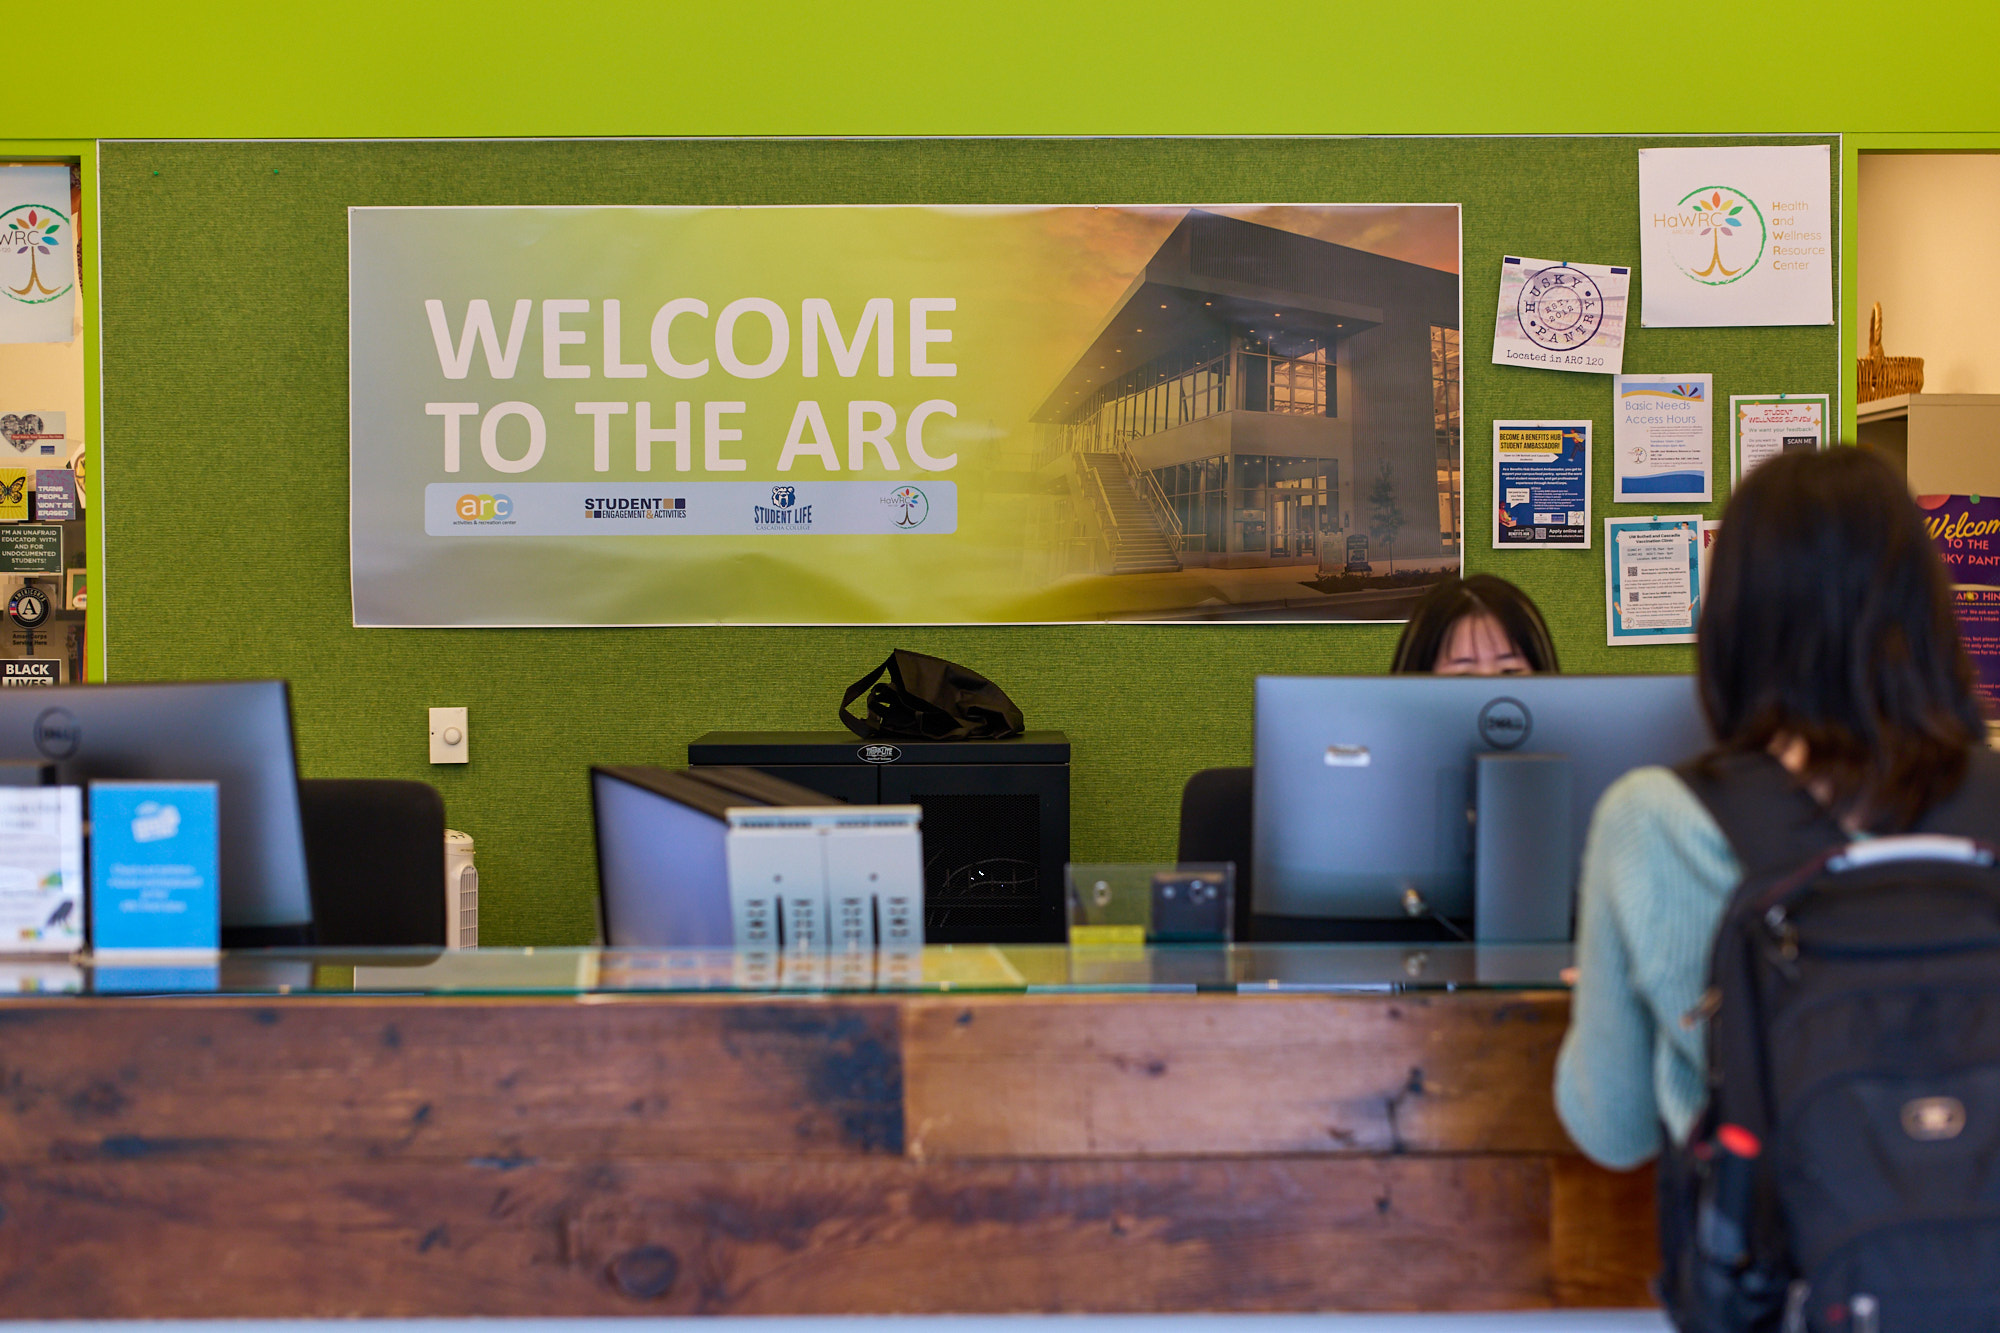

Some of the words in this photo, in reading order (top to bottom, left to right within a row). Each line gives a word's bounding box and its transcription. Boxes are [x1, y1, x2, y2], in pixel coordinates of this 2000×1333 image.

[1771, 200, 1809, 211] Health
[1653, 211, 1723, 228] HaWRC
[1771, 216, 1794, 226] and
[1772, 230, 1822, 241] Wellness
[1773, 245, 1825, 256] Resource
[1772, 260, 1809, 271] Center
[1525, 274, 1583, 313] HUSKY
[1549, 305, 1574, 323] 2012
[1535, 300, 1595, 343] PANTRY
[424, 297, 958, 380] WELCOME
[1506, 349, 1547, 362] Located
[1549, 354, 1562, 363] in
[1564, 355, 1584, 365] ARC
[1585, 356, 1604, 366] 120
[1625, 400, 1653, 411] Basic
[1655, 400, 1691, 410] Needs
[1625, 415, 1664, 424] Access
[1666, 414, 1696, 424] Hours
[424, 401, 547, 474] TO
[575, 400, 748, 473] THE
[776, 399, 958, 472] ARC
[1500, 433, 1520, 441] BECOME
[1521, 433, 1525, 441] A
[1525, 433, 1550, 441] BENEFITS
[1550, 433, 1562, 441] HUB
[1523, 442, 1560, 450] AMBASSADOR!
[461, 498, 508, 516] arc
[584, 498, 663, 510] STUDENT
[602, 509, 646, 519] ENGAGEMENT
[646, 509, 654, 519] &
[654, 509, 687, 519] ACTIVITIES
[754, 505, 792, 524] STUDENT
[794, 504, 813, 524] LIFE
[1946, 538, 1963, 549] TO
[1967, 538, 1990, 550] THE
[1940, 552, 1965, 565] SKY
[22, 598, 38, 615] A
[6, 663, 50, 675] BLACK
